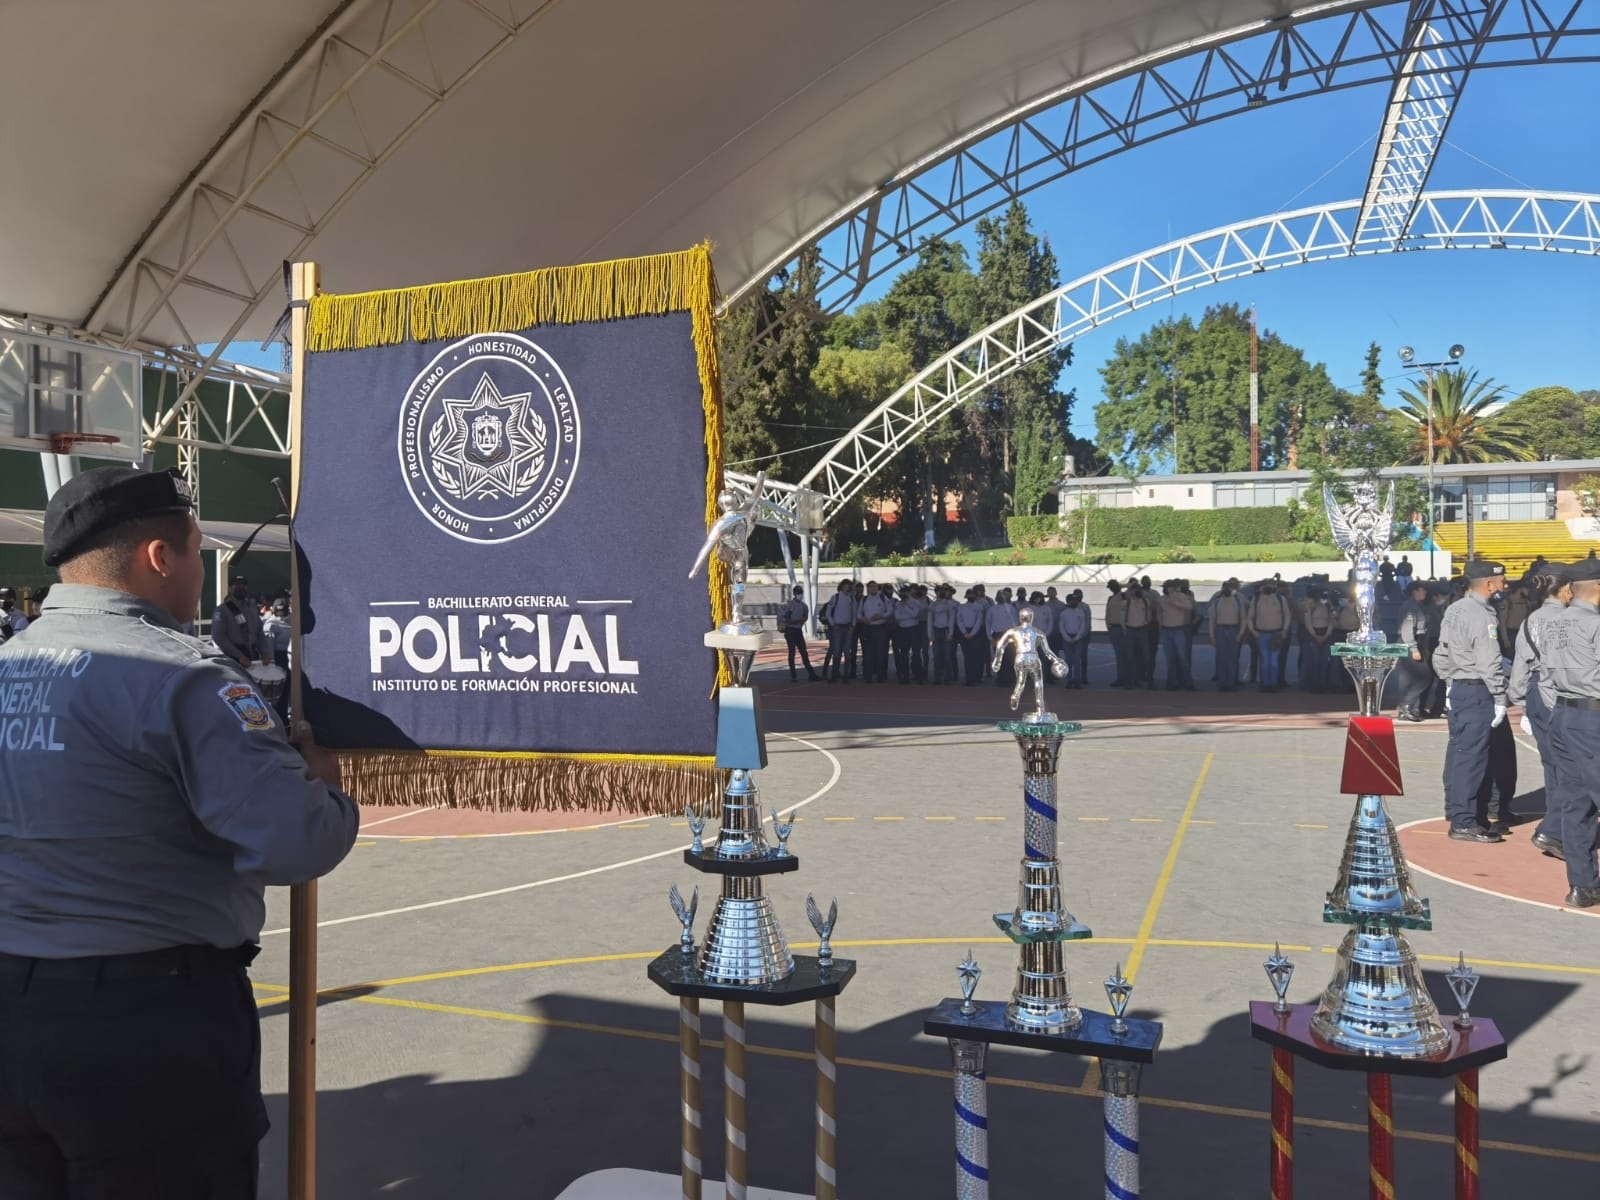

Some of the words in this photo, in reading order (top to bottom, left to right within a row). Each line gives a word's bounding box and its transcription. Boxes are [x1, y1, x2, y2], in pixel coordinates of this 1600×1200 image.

[468, 341, 537, 365] HONESTIDAD
[406, 366, 445, 479] PROFESIONALISMO
[553, 386, 574, 443] LEALTAD
[432, 503, 470, 533] HONOR
[513, 477, 565, 530] DISCIPLINA
[427, 596, 513, 609] BACHILLERATO
[514, 595, 570, 608] GENERAL
[369, 613, 640, 675] POLICIAL
[372, 679, 439, 691] INSTITUTO
[441, 679, 458, 691] DE
[462, 677, 540, 693] FORMACIÓN
[543, 680, 639, 695] PROFESIONAL
